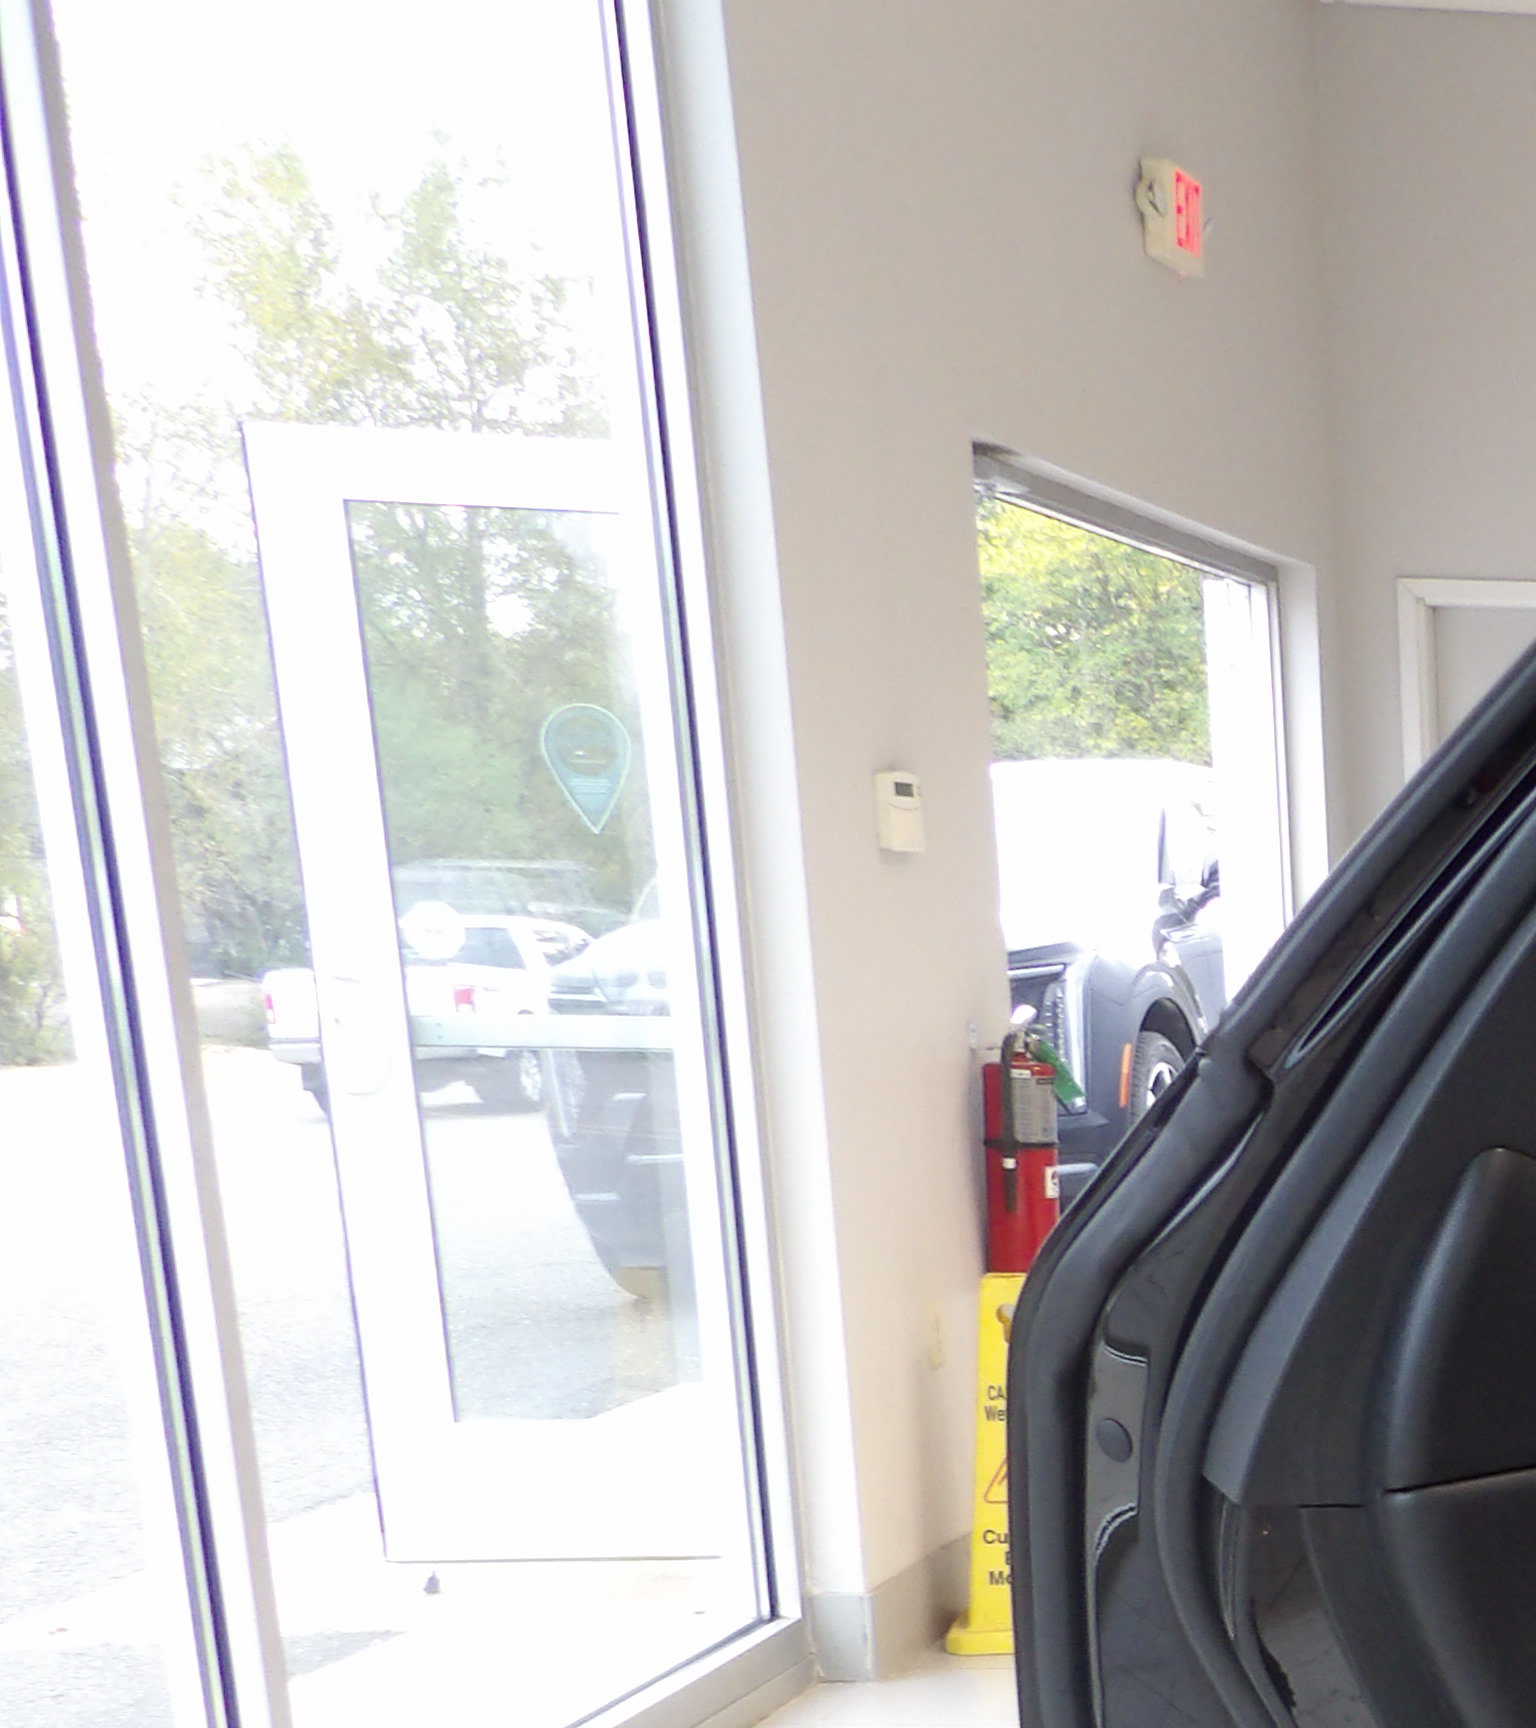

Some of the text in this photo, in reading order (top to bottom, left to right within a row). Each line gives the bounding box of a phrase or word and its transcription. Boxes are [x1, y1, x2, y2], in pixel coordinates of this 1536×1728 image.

[987, 1385, 1007, 1400] CA
[985, 1406, 1007, 1422] We
[983, 1530, 1008, 1545] Cu
